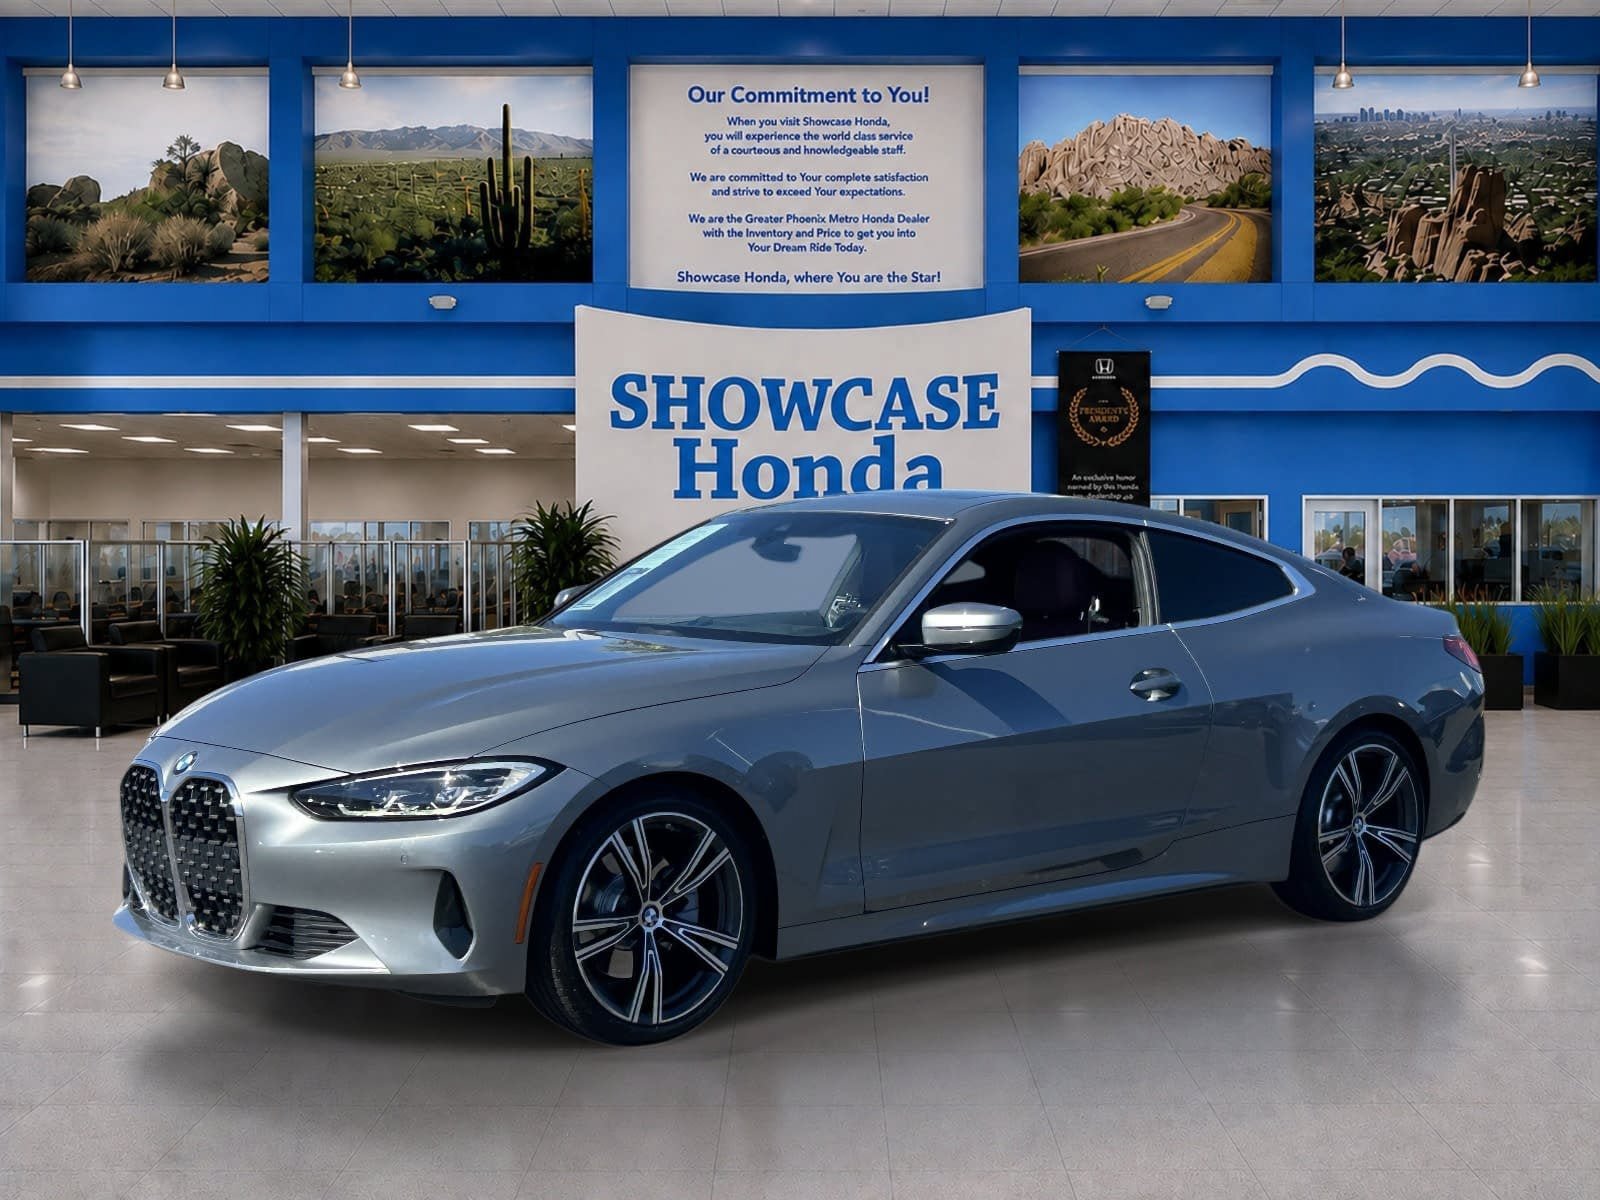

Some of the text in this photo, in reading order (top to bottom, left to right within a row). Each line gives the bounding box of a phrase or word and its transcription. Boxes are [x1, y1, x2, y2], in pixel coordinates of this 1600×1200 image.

[687, 86, 929, 104] Our Commitment to You!
[726, 116, 891, 129] When you visit Showcase Honda,
[704, 130, 914, 144] you will experience the world class service
[709, 144, 722, 155] of
[722, 147, 730, 155] a
[730, 146, 781, 156] courteous
[782, 144, 802, 155] and
[881, 144, 906, 155] staff.
[689, 171, 929, 185] We are committed to Your complete satisfaction
[711, 185, 906, 200] and strive to exceed Your expectations.
[688, 213, 931, 224] We are the Greater Phoenix Metro Honda Dealer
[702, 227, 917, 241] with the Inventory and Price to get you into
[747, 241, 868, 255] Your Dream Ride Today.
[676, 271, 941, 286] Showcase Honda, where You are the Star!
[609, 373, 1000, 431] SHOWCASE
[673, 434, 943, 500] Honda
